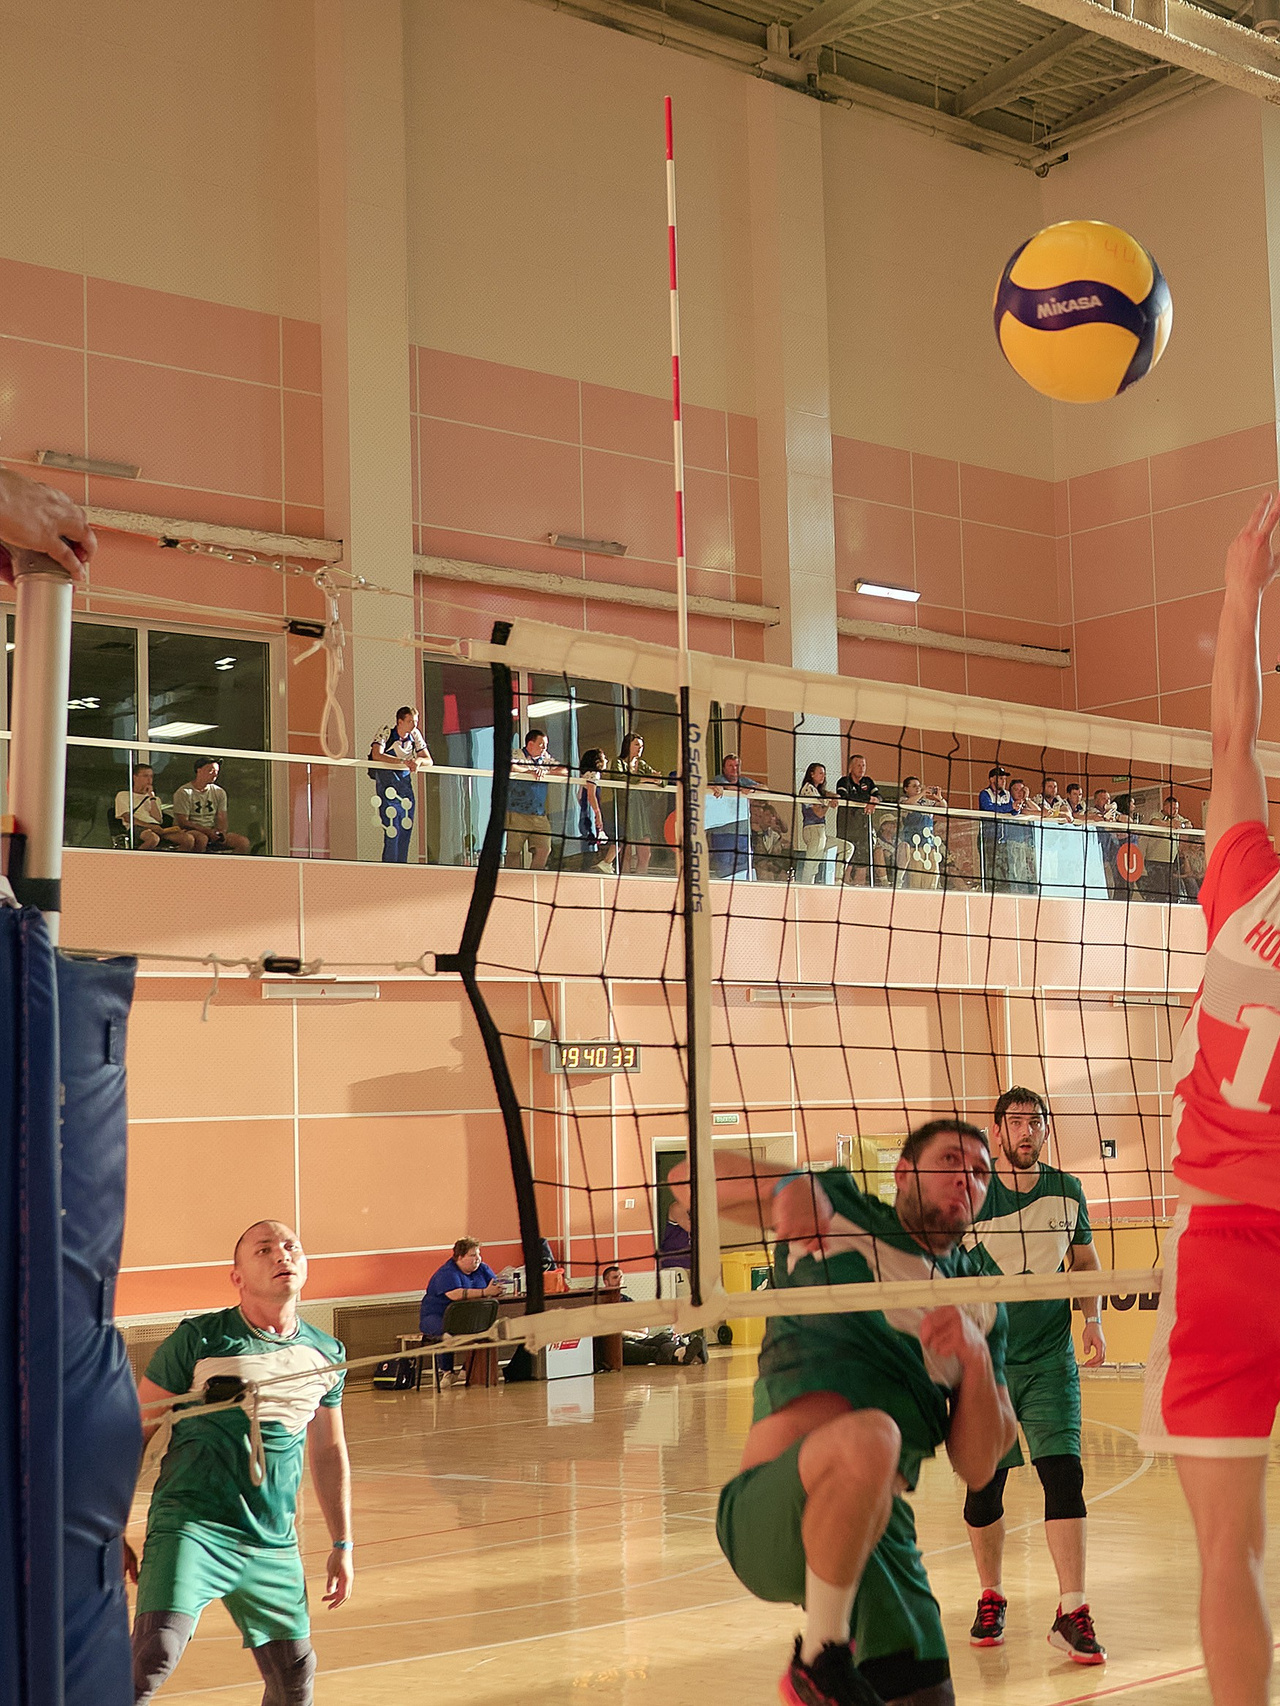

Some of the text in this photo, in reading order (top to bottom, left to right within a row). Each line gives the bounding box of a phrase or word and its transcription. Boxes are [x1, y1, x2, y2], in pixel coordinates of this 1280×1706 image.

[561, 1046, 635, 1068] 19 40 33
